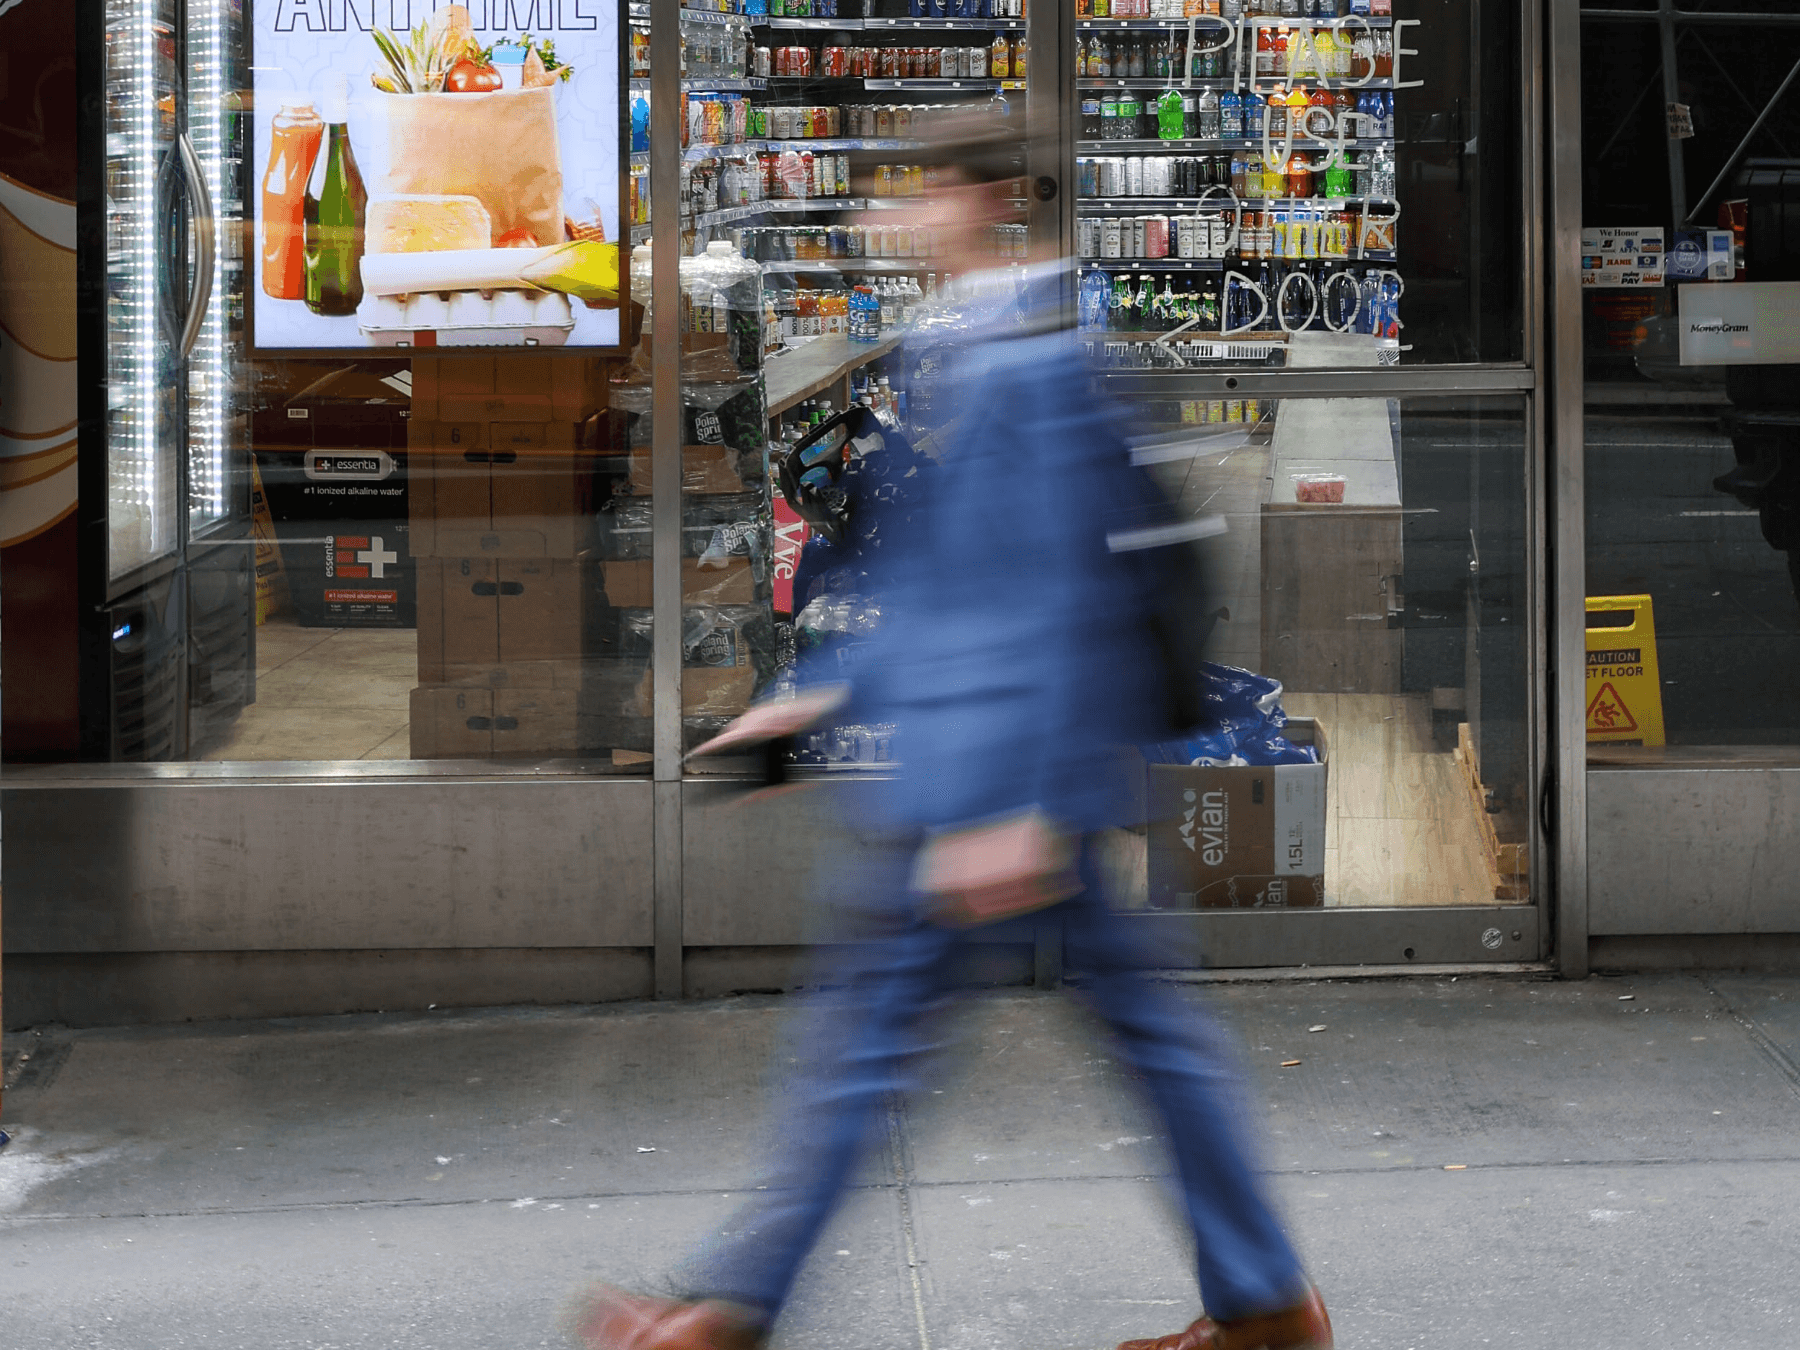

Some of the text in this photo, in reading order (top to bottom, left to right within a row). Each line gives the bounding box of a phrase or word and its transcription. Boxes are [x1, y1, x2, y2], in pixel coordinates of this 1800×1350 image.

[1263, 104, 1369, 172] USE
[1195, 183, 1401, 260] OTHER
[1600, 229, 1639, 237] We Honor
[1220, 270, 1405, 335] DOOR
[1690, 323, 1749, 334] MoneyGram
[337, 460, 377, 469] essentia
[317, 487, 346, 495] ionized
[347, 487, 378, 495] alkaline
[380, 488, 404, 496] water
[325, 535, 334, 577] essentia
[1588, 652, 1636, 663] AUTION
[1586, 667, 1644, 678] ET FLOOR
[1289, 839, 1303, 869] 1.5L
